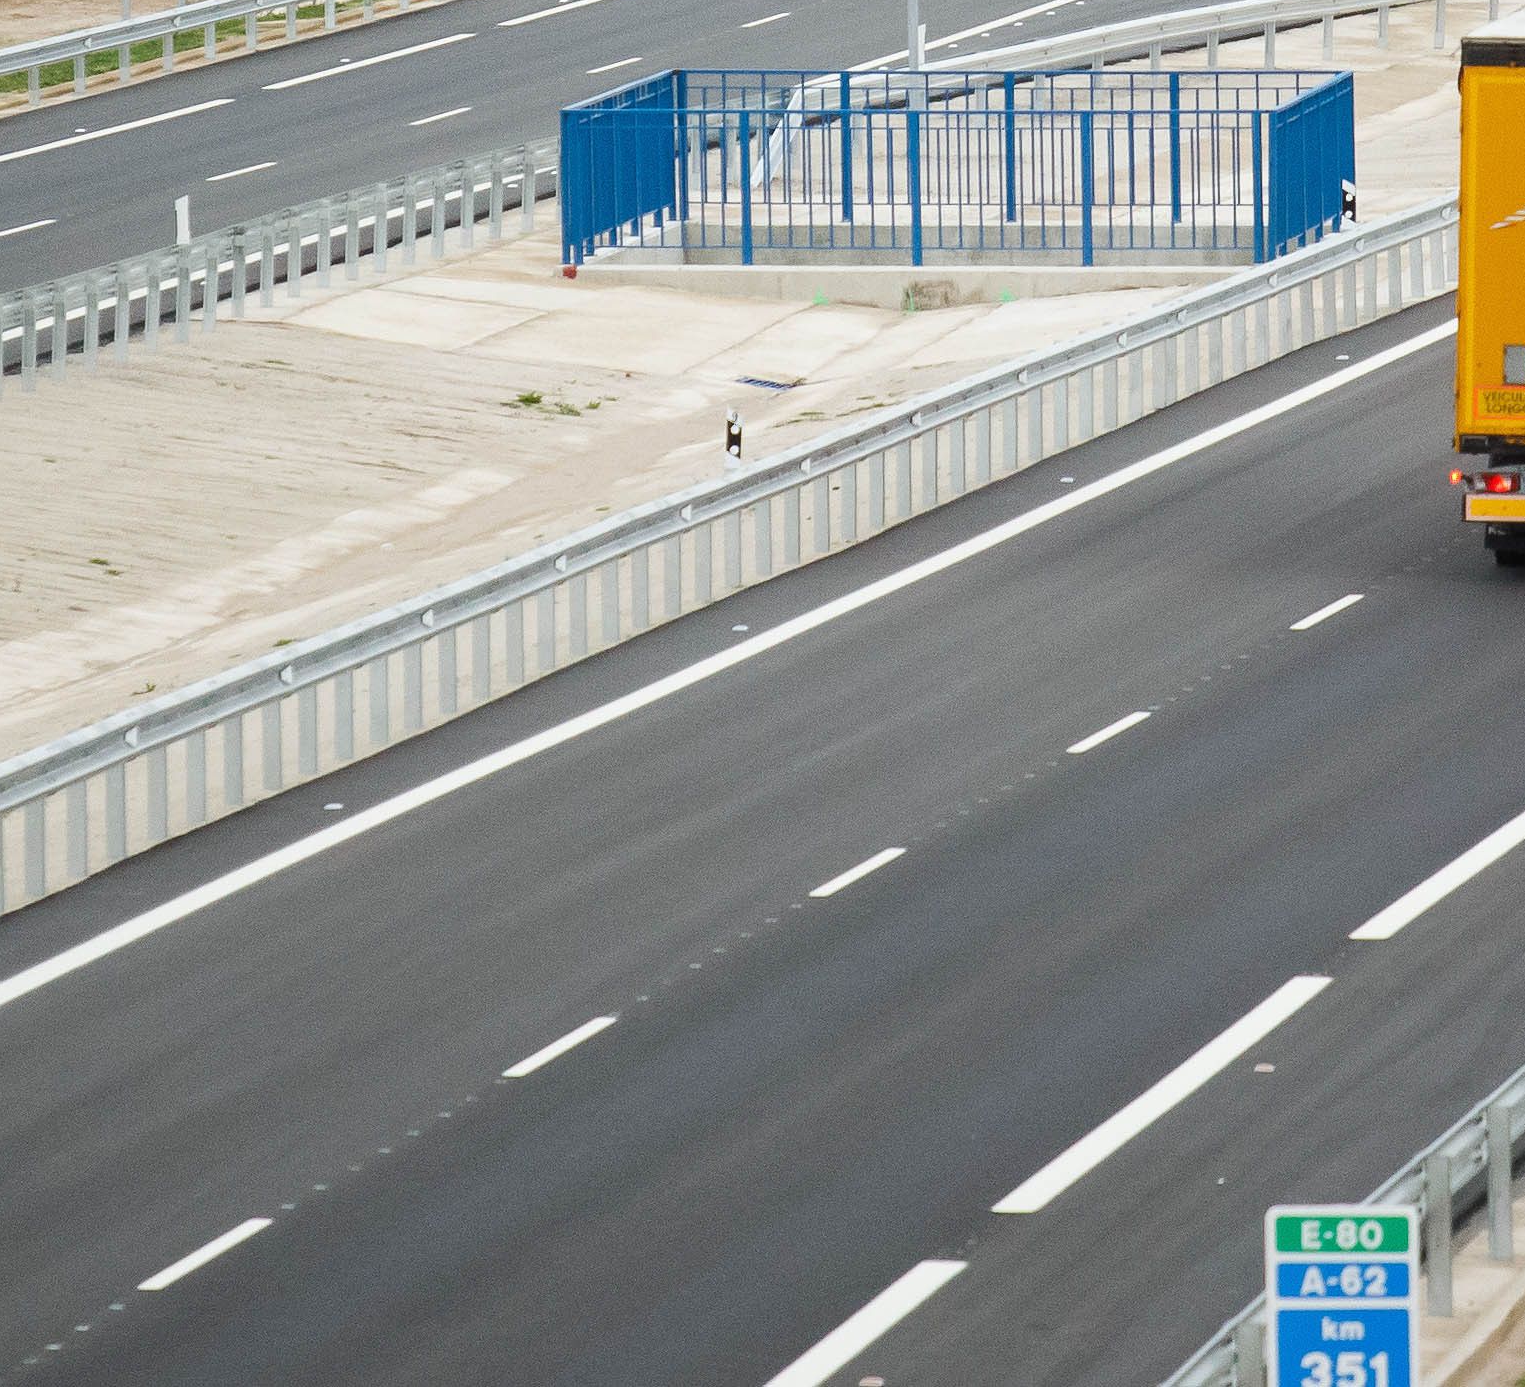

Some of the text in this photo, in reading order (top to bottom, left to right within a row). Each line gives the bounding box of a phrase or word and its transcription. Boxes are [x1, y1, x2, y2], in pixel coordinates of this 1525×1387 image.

[1301, 1219, 1384, 1250] E-80
[1300, 1265, 1388, 1296] A-62
[1321, 1316, 1365, 1341] km
[1300, 1351, 1389, 1387] 351
